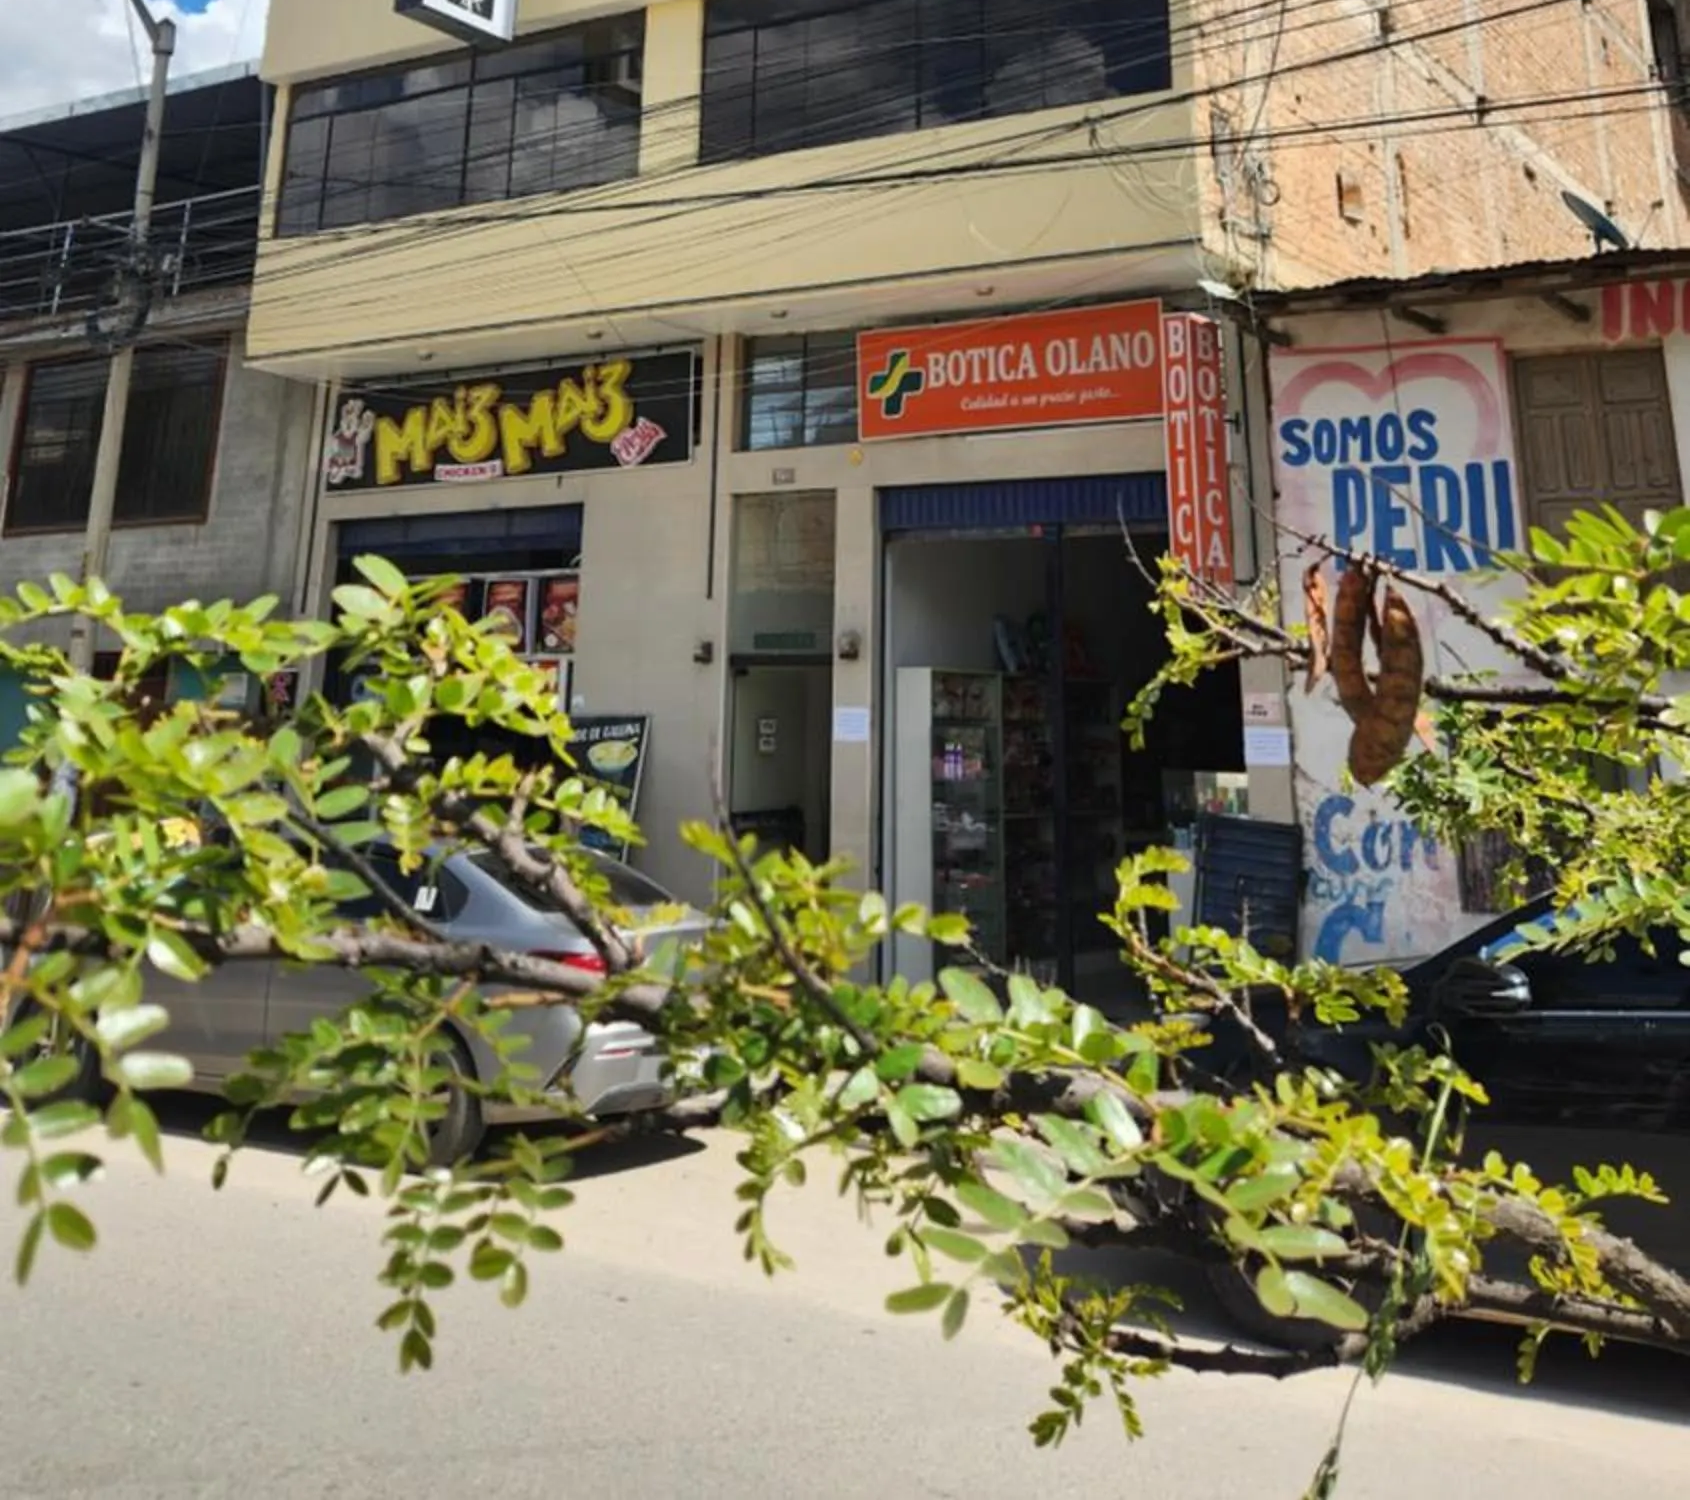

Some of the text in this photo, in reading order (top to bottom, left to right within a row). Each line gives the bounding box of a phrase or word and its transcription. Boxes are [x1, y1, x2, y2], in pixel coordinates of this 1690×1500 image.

[1602, 280, 1690, 341] IN
[926, 330, 1155, 389] BOTICA OLANO
[1196, 325, 1229, 568] BOTICA
[1279, 408, 1439, 466] SOMOS
[1332, 460, 1516, 572] PERU
